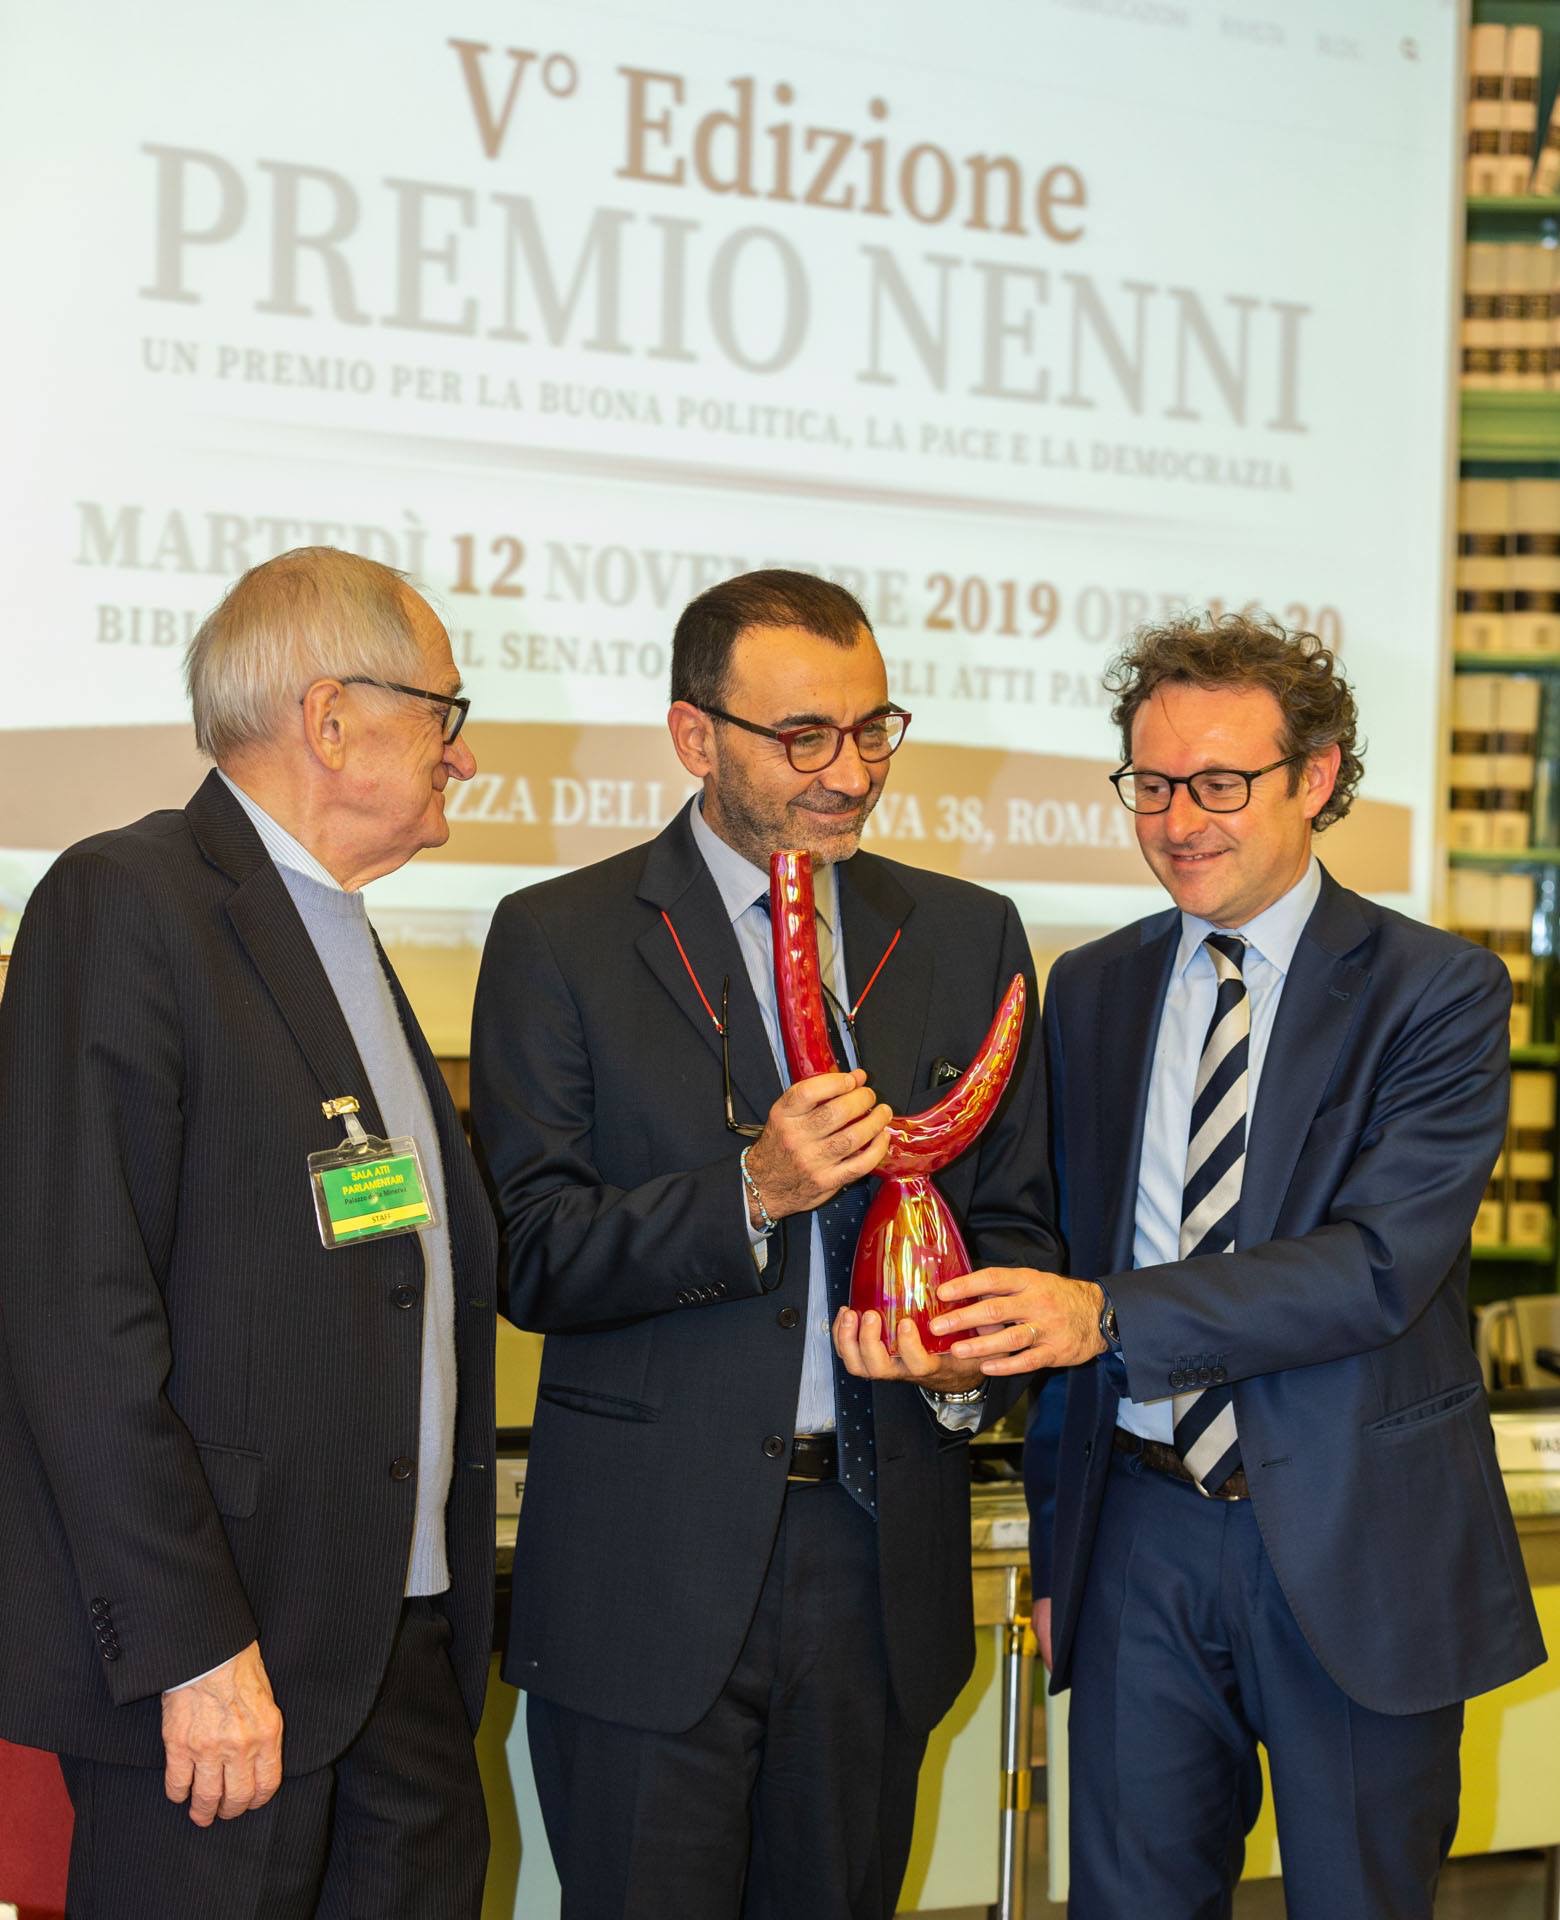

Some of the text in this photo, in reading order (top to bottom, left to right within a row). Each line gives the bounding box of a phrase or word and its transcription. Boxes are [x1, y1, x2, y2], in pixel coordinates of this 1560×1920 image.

[446, 36, 1089, 245] V° Edizione
[138, 142, 1312, 436] PREMIO NENNI
[140, 337, 1294, 492] UN PREMIO PER LA BUONA POLITICA, LA PACE E LA DEMOCRAZIA
[450, 533, 526, 599] 12
[922, 571, 1060, 639] 2019
[500, 632, 662, 677] SENATO
[951, 665, 1034, 705] ATTI
[934, 796, 997, 855] 38,
[1007, 797, 1133, 848] ROMA
[341, 1174, 404, 1196] PARLAMENTARI
[344, 1195, 367, 1205] Palazzo
[351, 1164, 391, 1181] SALA ATTI
